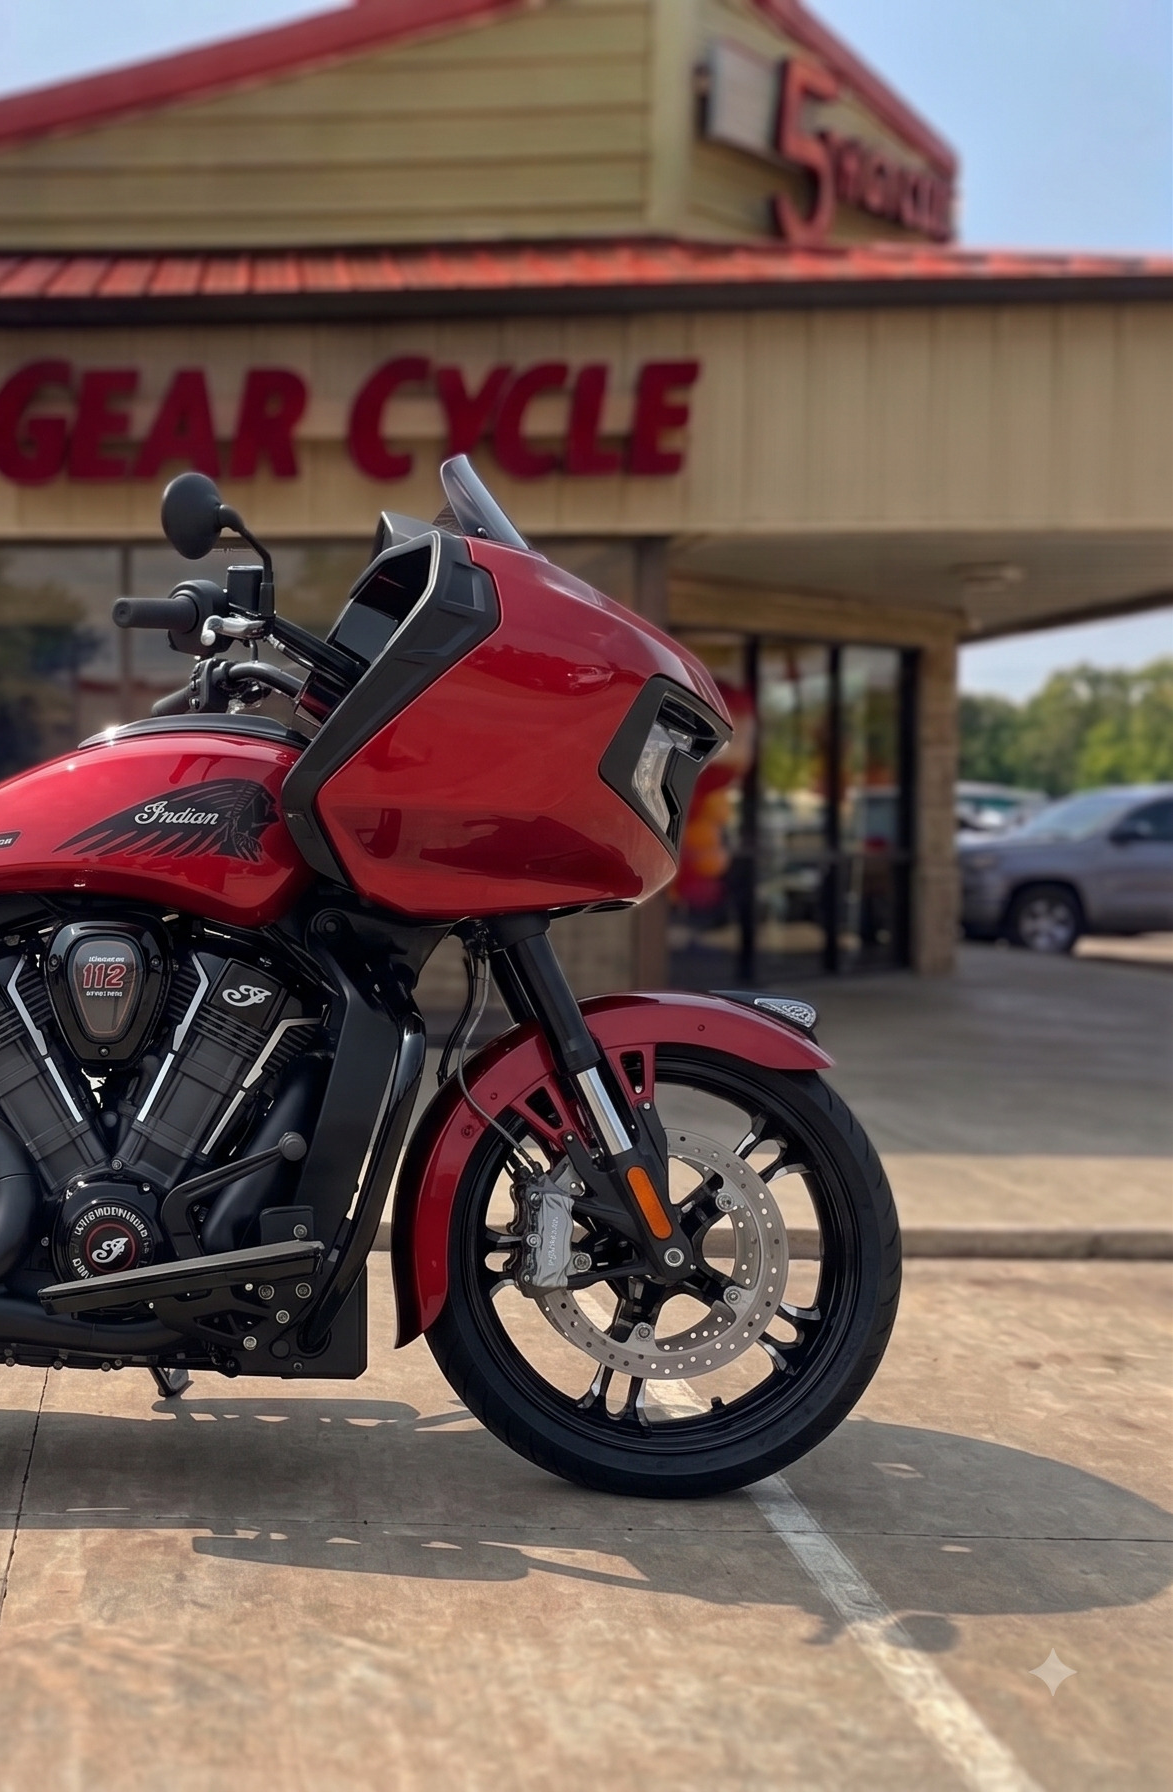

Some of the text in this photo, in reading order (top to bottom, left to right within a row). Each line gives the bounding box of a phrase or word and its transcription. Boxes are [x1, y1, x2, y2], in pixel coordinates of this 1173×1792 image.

[348, 356, 701, 481] CYCLE
[134, 800, 219, 825] Indian
[83, 962, 127, 989] 112
